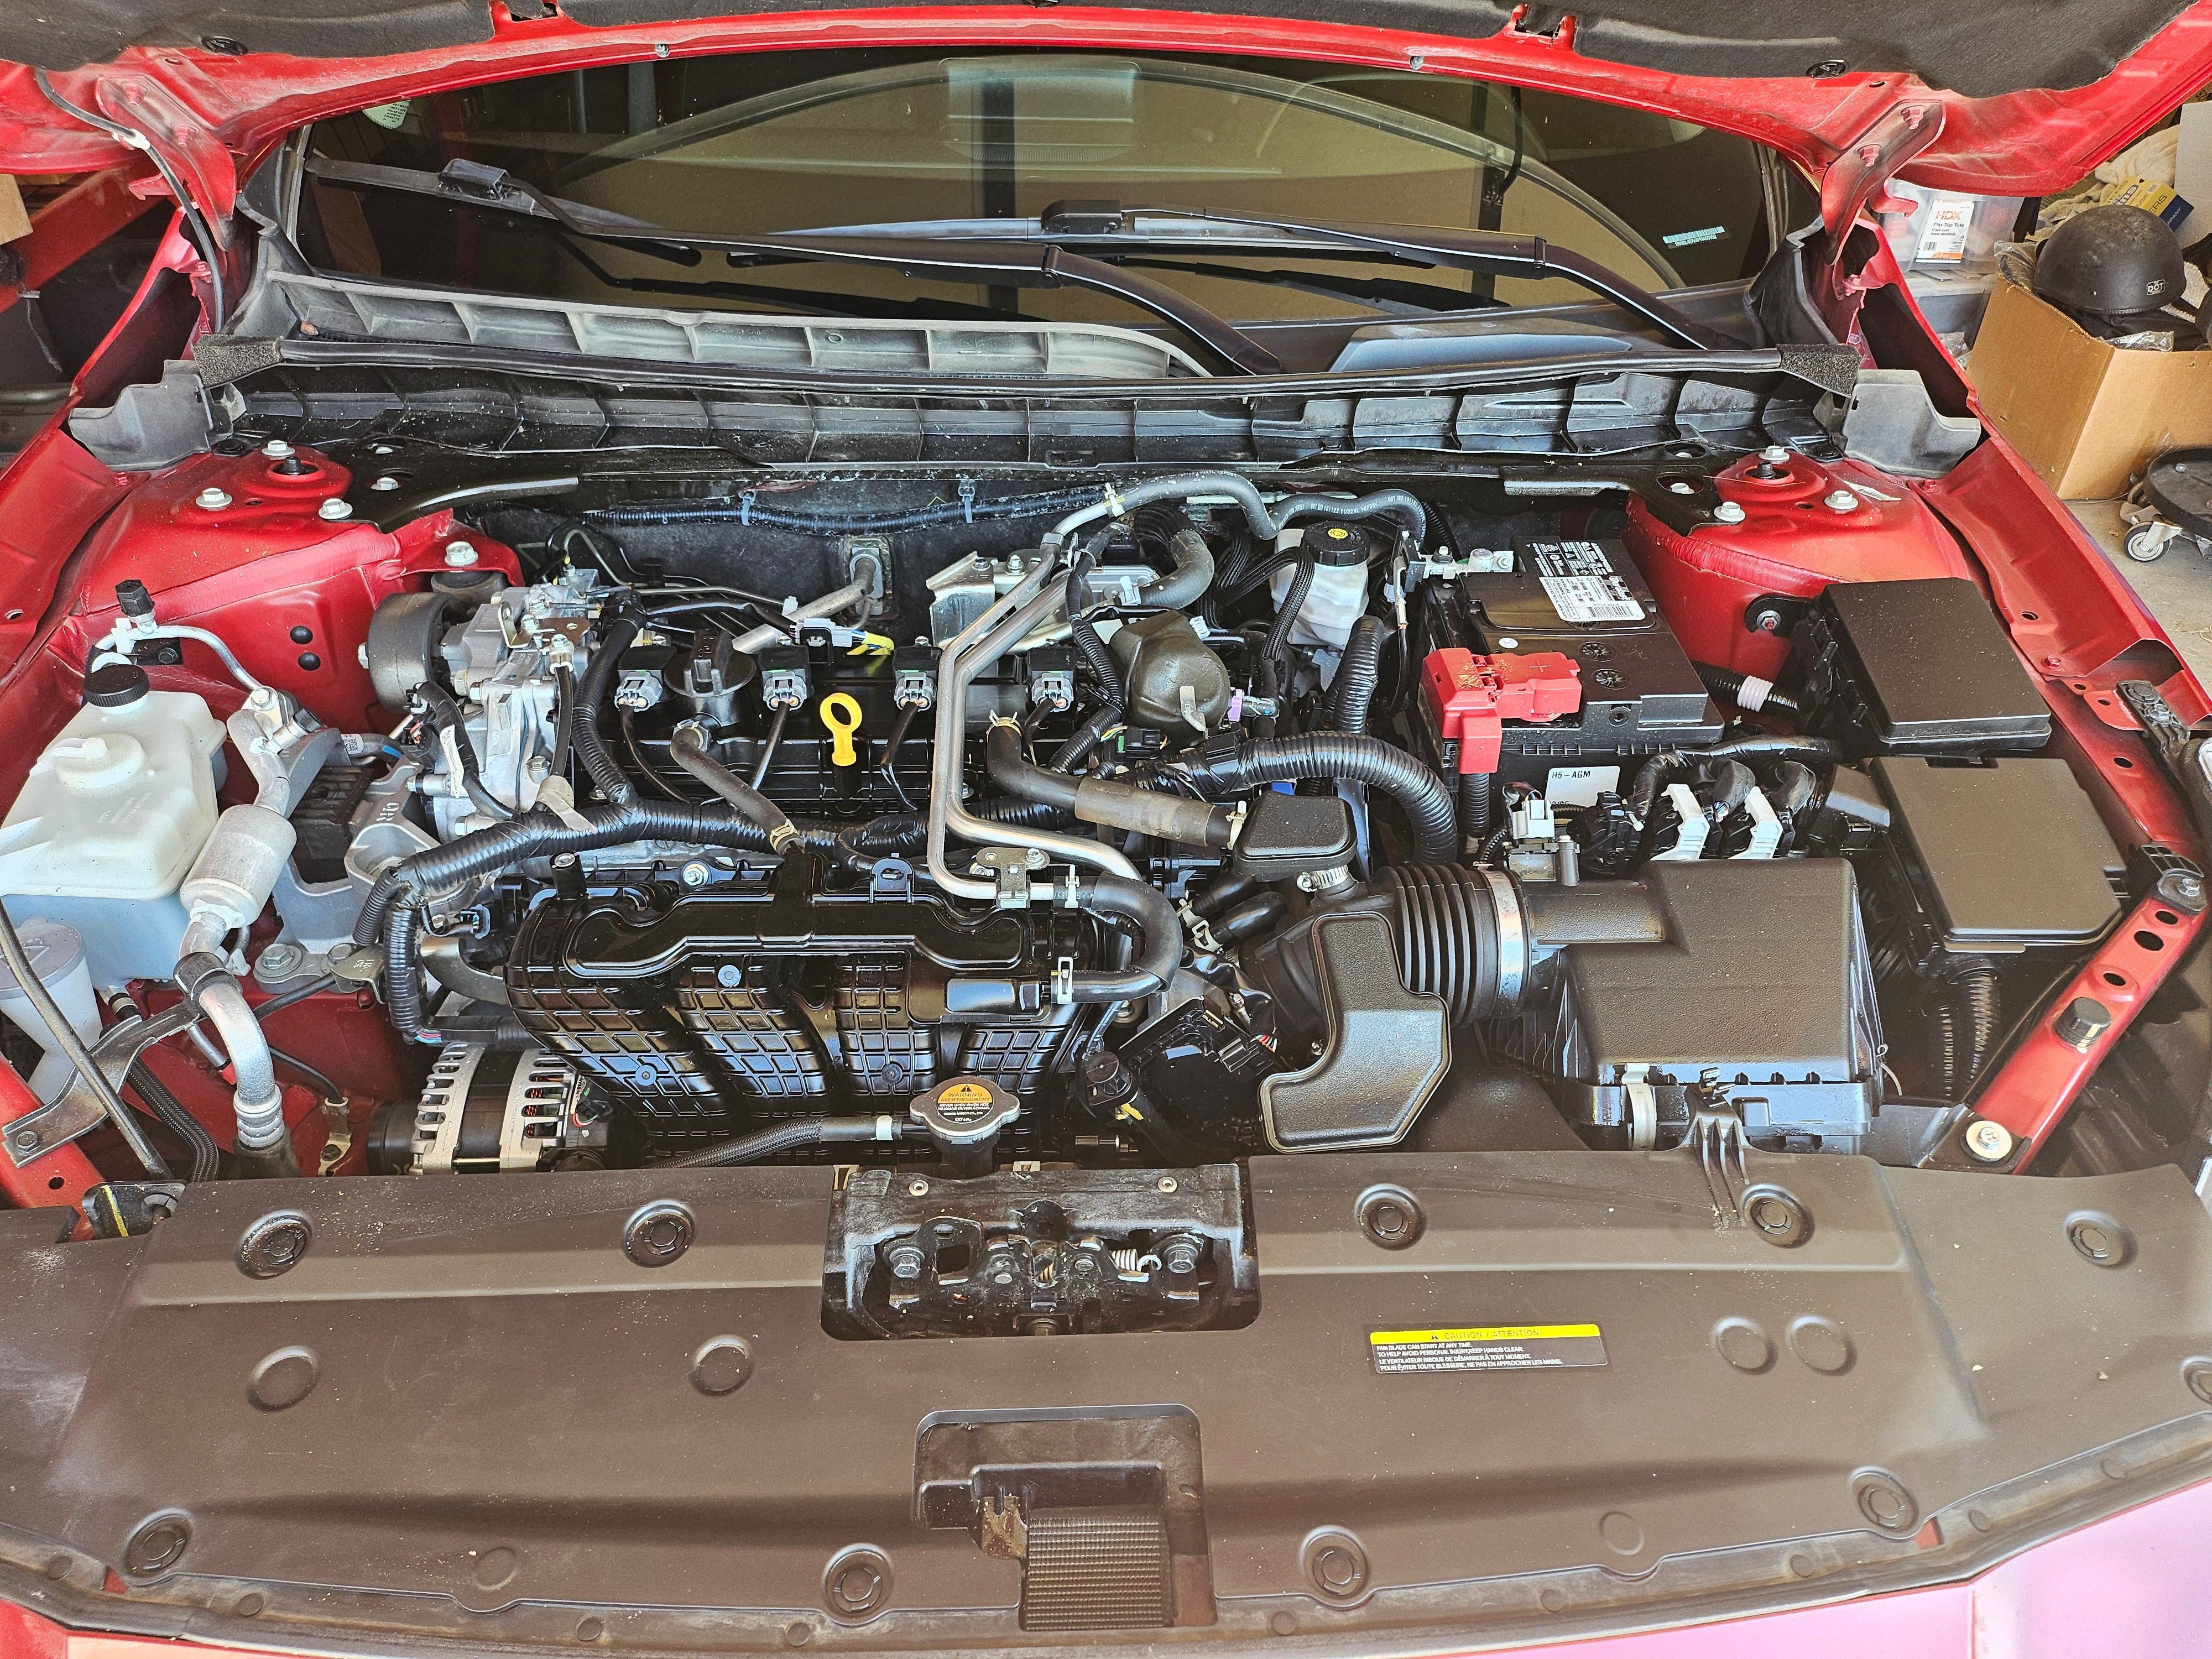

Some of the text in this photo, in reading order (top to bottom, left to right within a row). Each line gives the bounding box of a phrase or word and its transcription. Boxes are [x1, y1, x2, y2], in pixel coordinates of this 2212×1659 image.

[2149, 195, 2167, 213] ERS
[1936, 211, 1963, 220] HDX
[2167, 206, 2181, 226] MPANY
[2148, 283, 2163, 293] DOT
[1324, 505, 1339, 514] 101122
[1552, 770, 1591, 779] H5-AGM
